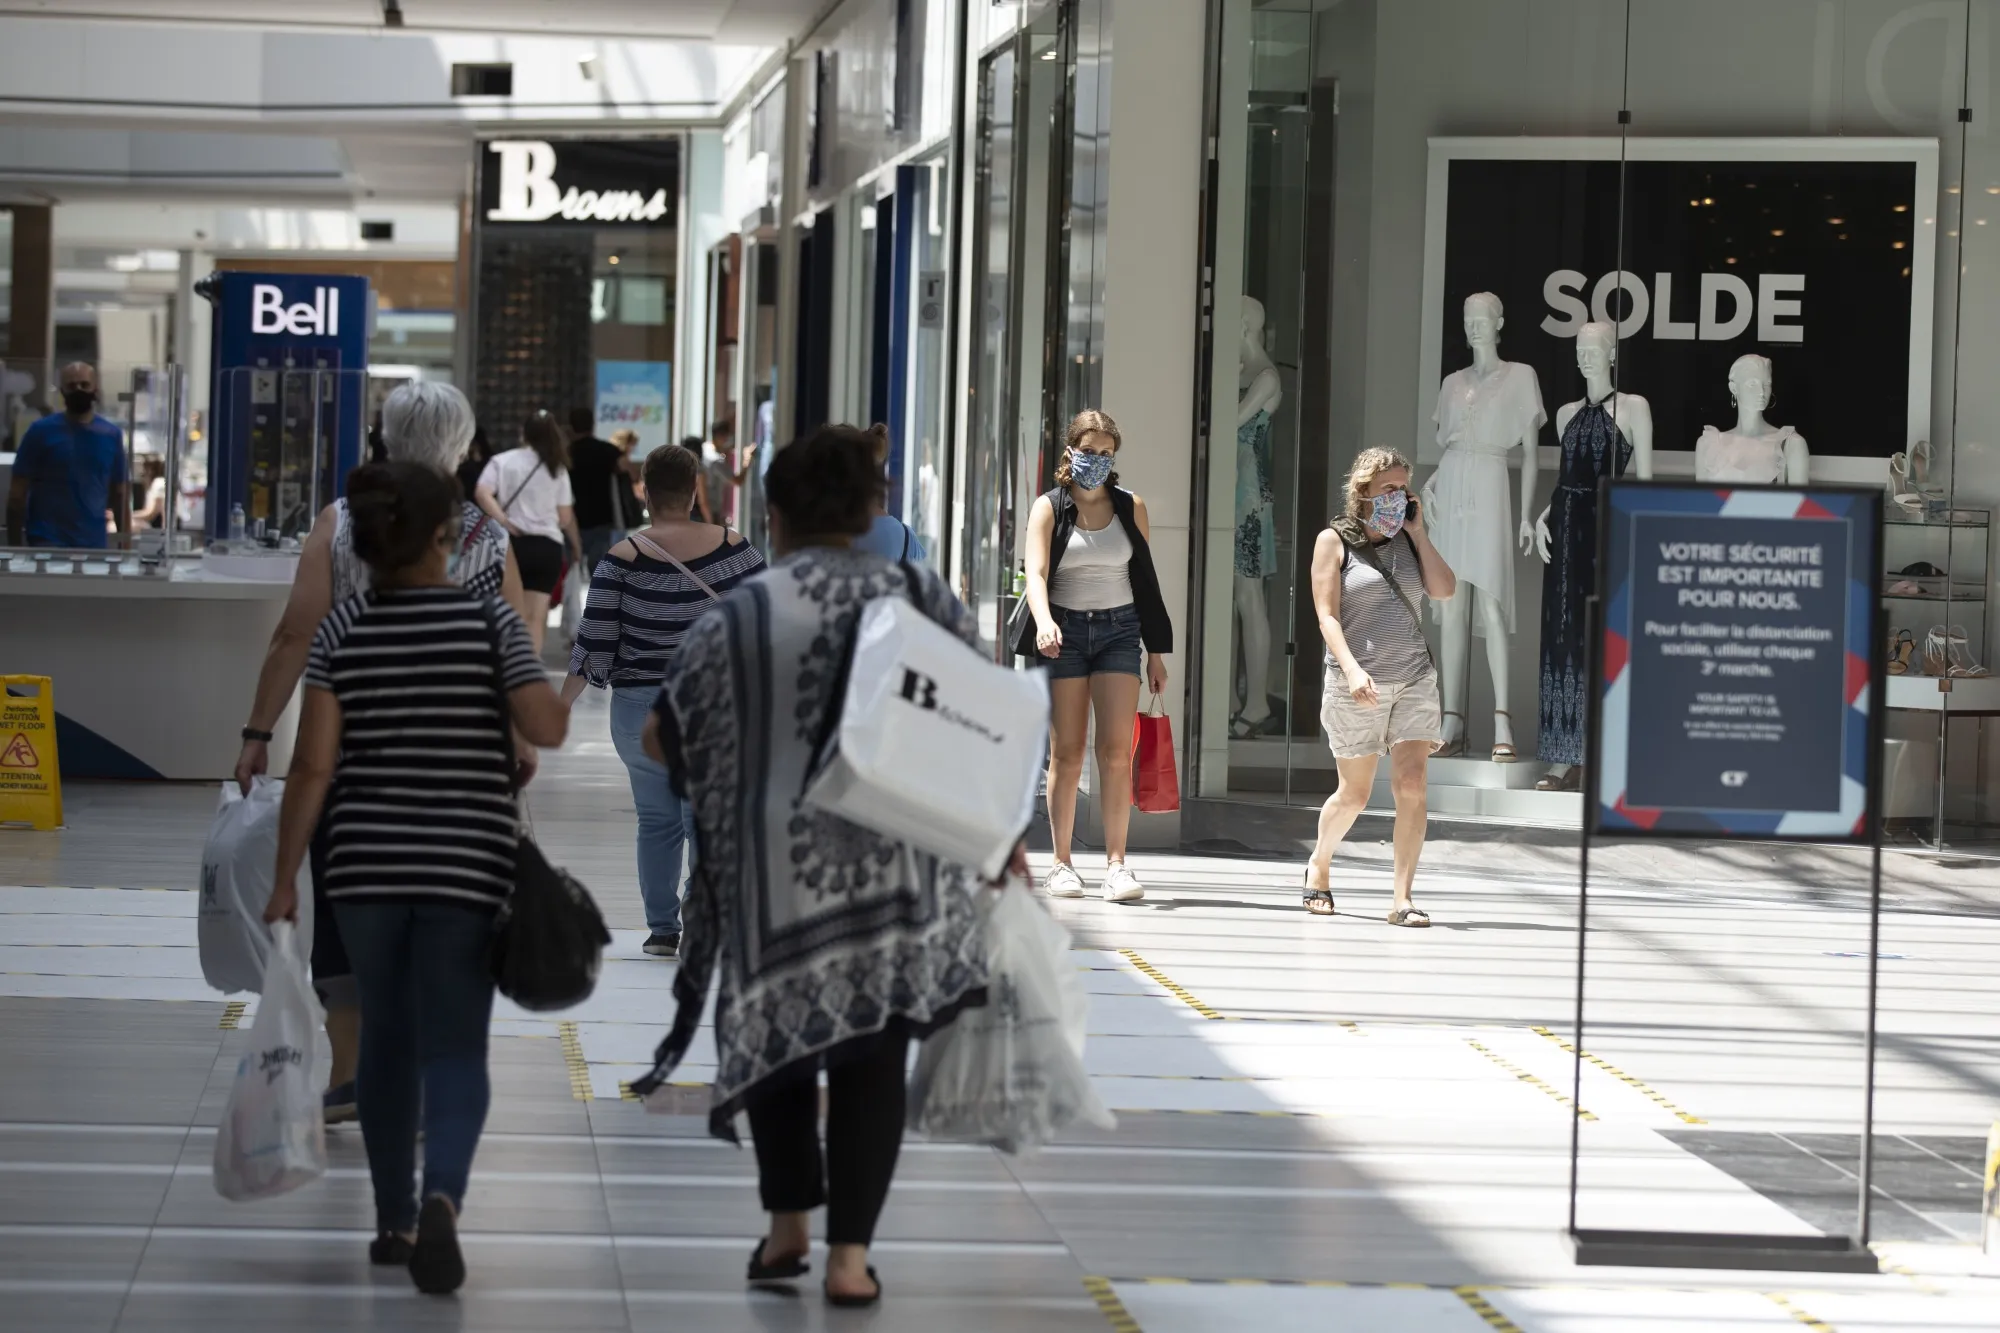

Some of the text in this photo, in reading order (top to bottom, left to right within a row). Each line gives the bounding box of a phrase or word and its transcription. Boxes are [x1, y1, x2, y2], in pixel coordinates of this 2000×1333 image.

[487, 140, 667, 221] Browns
[252, 284, 339, 336] Bell
[1540, 269, 1805, 342] SOLDE
[1659, 541, 1822, 566] VOTRE SÉCURITÉ
[1657, 565, 1823, 588] EST IMPORTANTE
[1677, 588, 1801, 610] POUR NOUS.
[1645, 620, 1677, 636] Pour
[1680, 621, 1729, 638] faciliter
[1746, 624, 1833, 641] distanciation
[1714, 643, 1760, 658] utilisez
[1763, 645, 1816, 661] chaque
[3, 712, 40, 721] CAUTION
[18, 722, 46, 730] FLOOR
[0, 772, 42, 781] TTENTION
